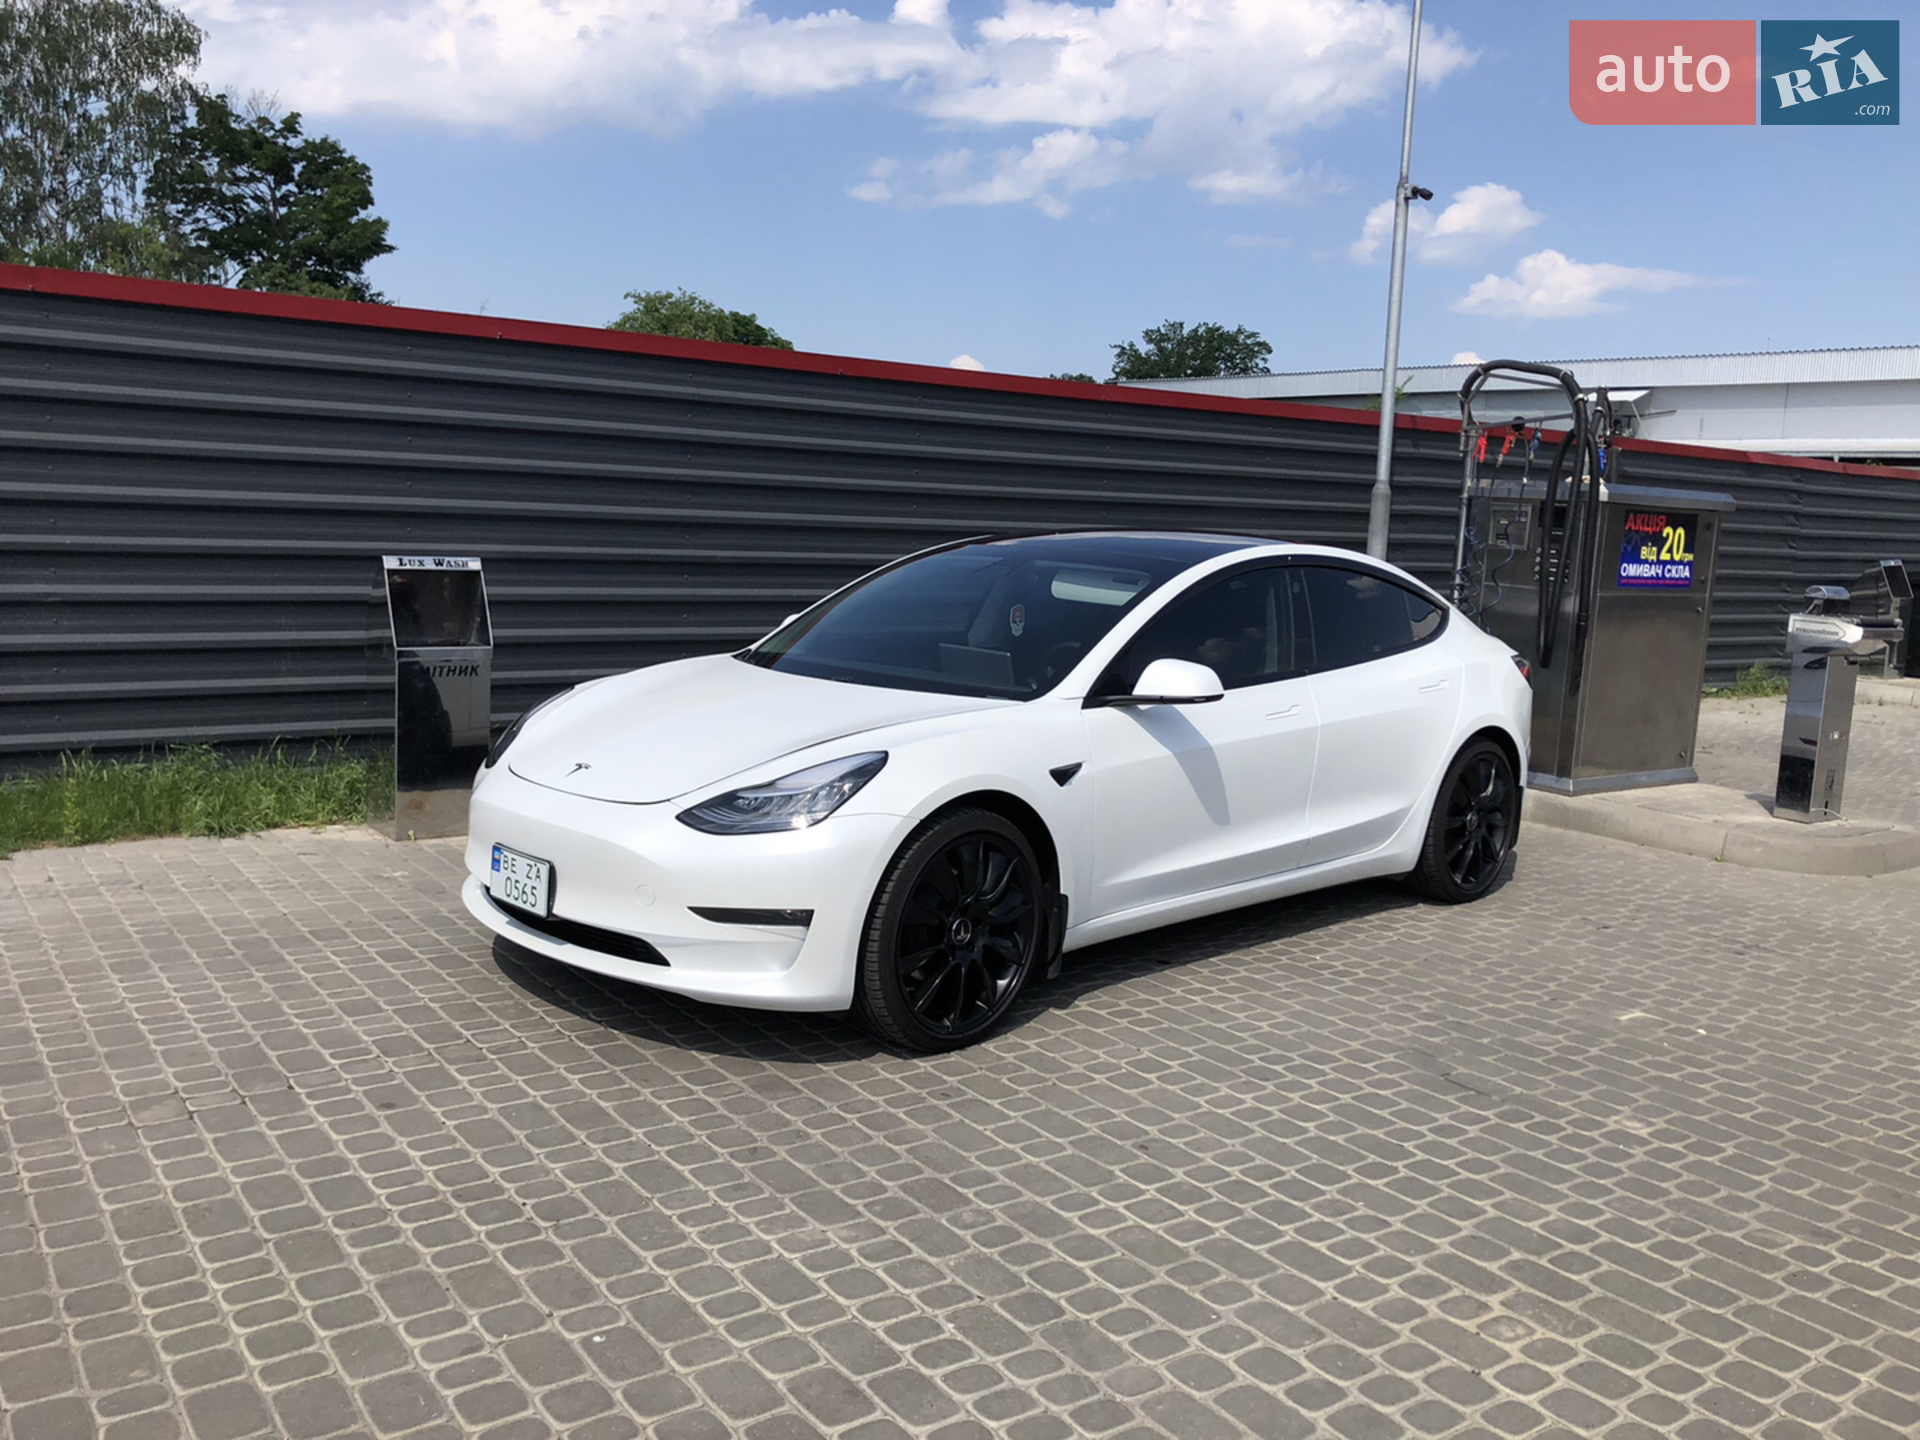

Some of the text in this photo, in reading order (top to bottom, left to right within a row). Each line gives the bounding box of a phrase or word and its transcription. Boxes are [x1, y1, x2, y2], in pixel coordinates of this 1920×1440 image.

[1625, 513, 1667, 536] АКЦІЯ
[1640, 542, 1657, 562] від
[1660, 525, 1685, 561] 20
[1620, 563, 1690, 578] ОМИВАЧ СКЛА
[503, 854, 517, 875] BE
[526, 863, 542, 883] ZA
[504, 876, 538, 908] 0565
